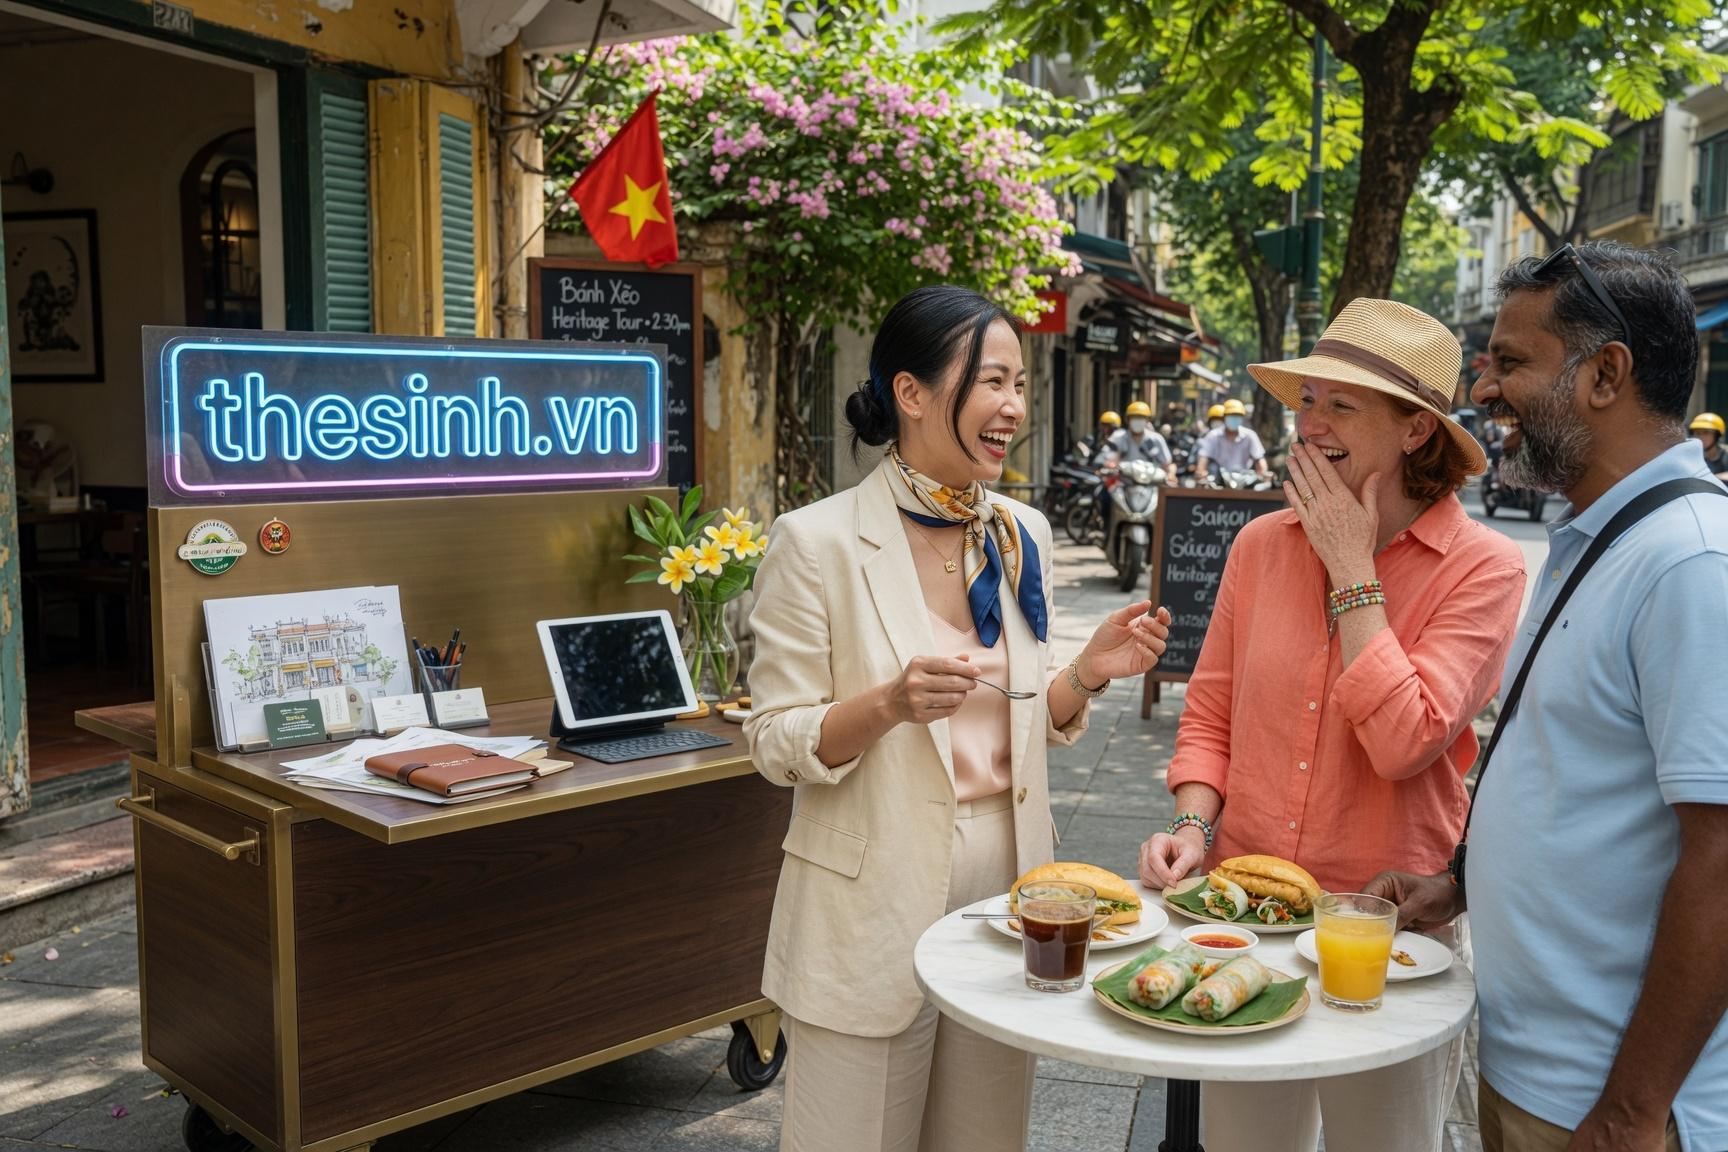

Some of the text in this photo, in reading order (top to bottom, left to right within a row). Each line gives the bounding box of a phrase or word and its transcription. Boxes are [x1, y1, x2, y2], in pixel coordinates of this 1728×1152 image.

[559, 276, 604, 304] Bánh
[552, 306, 609, 339] Heritage
[612, 308, 643, 330] Tour
[198, 372, 639, 462] thesinh.vn
